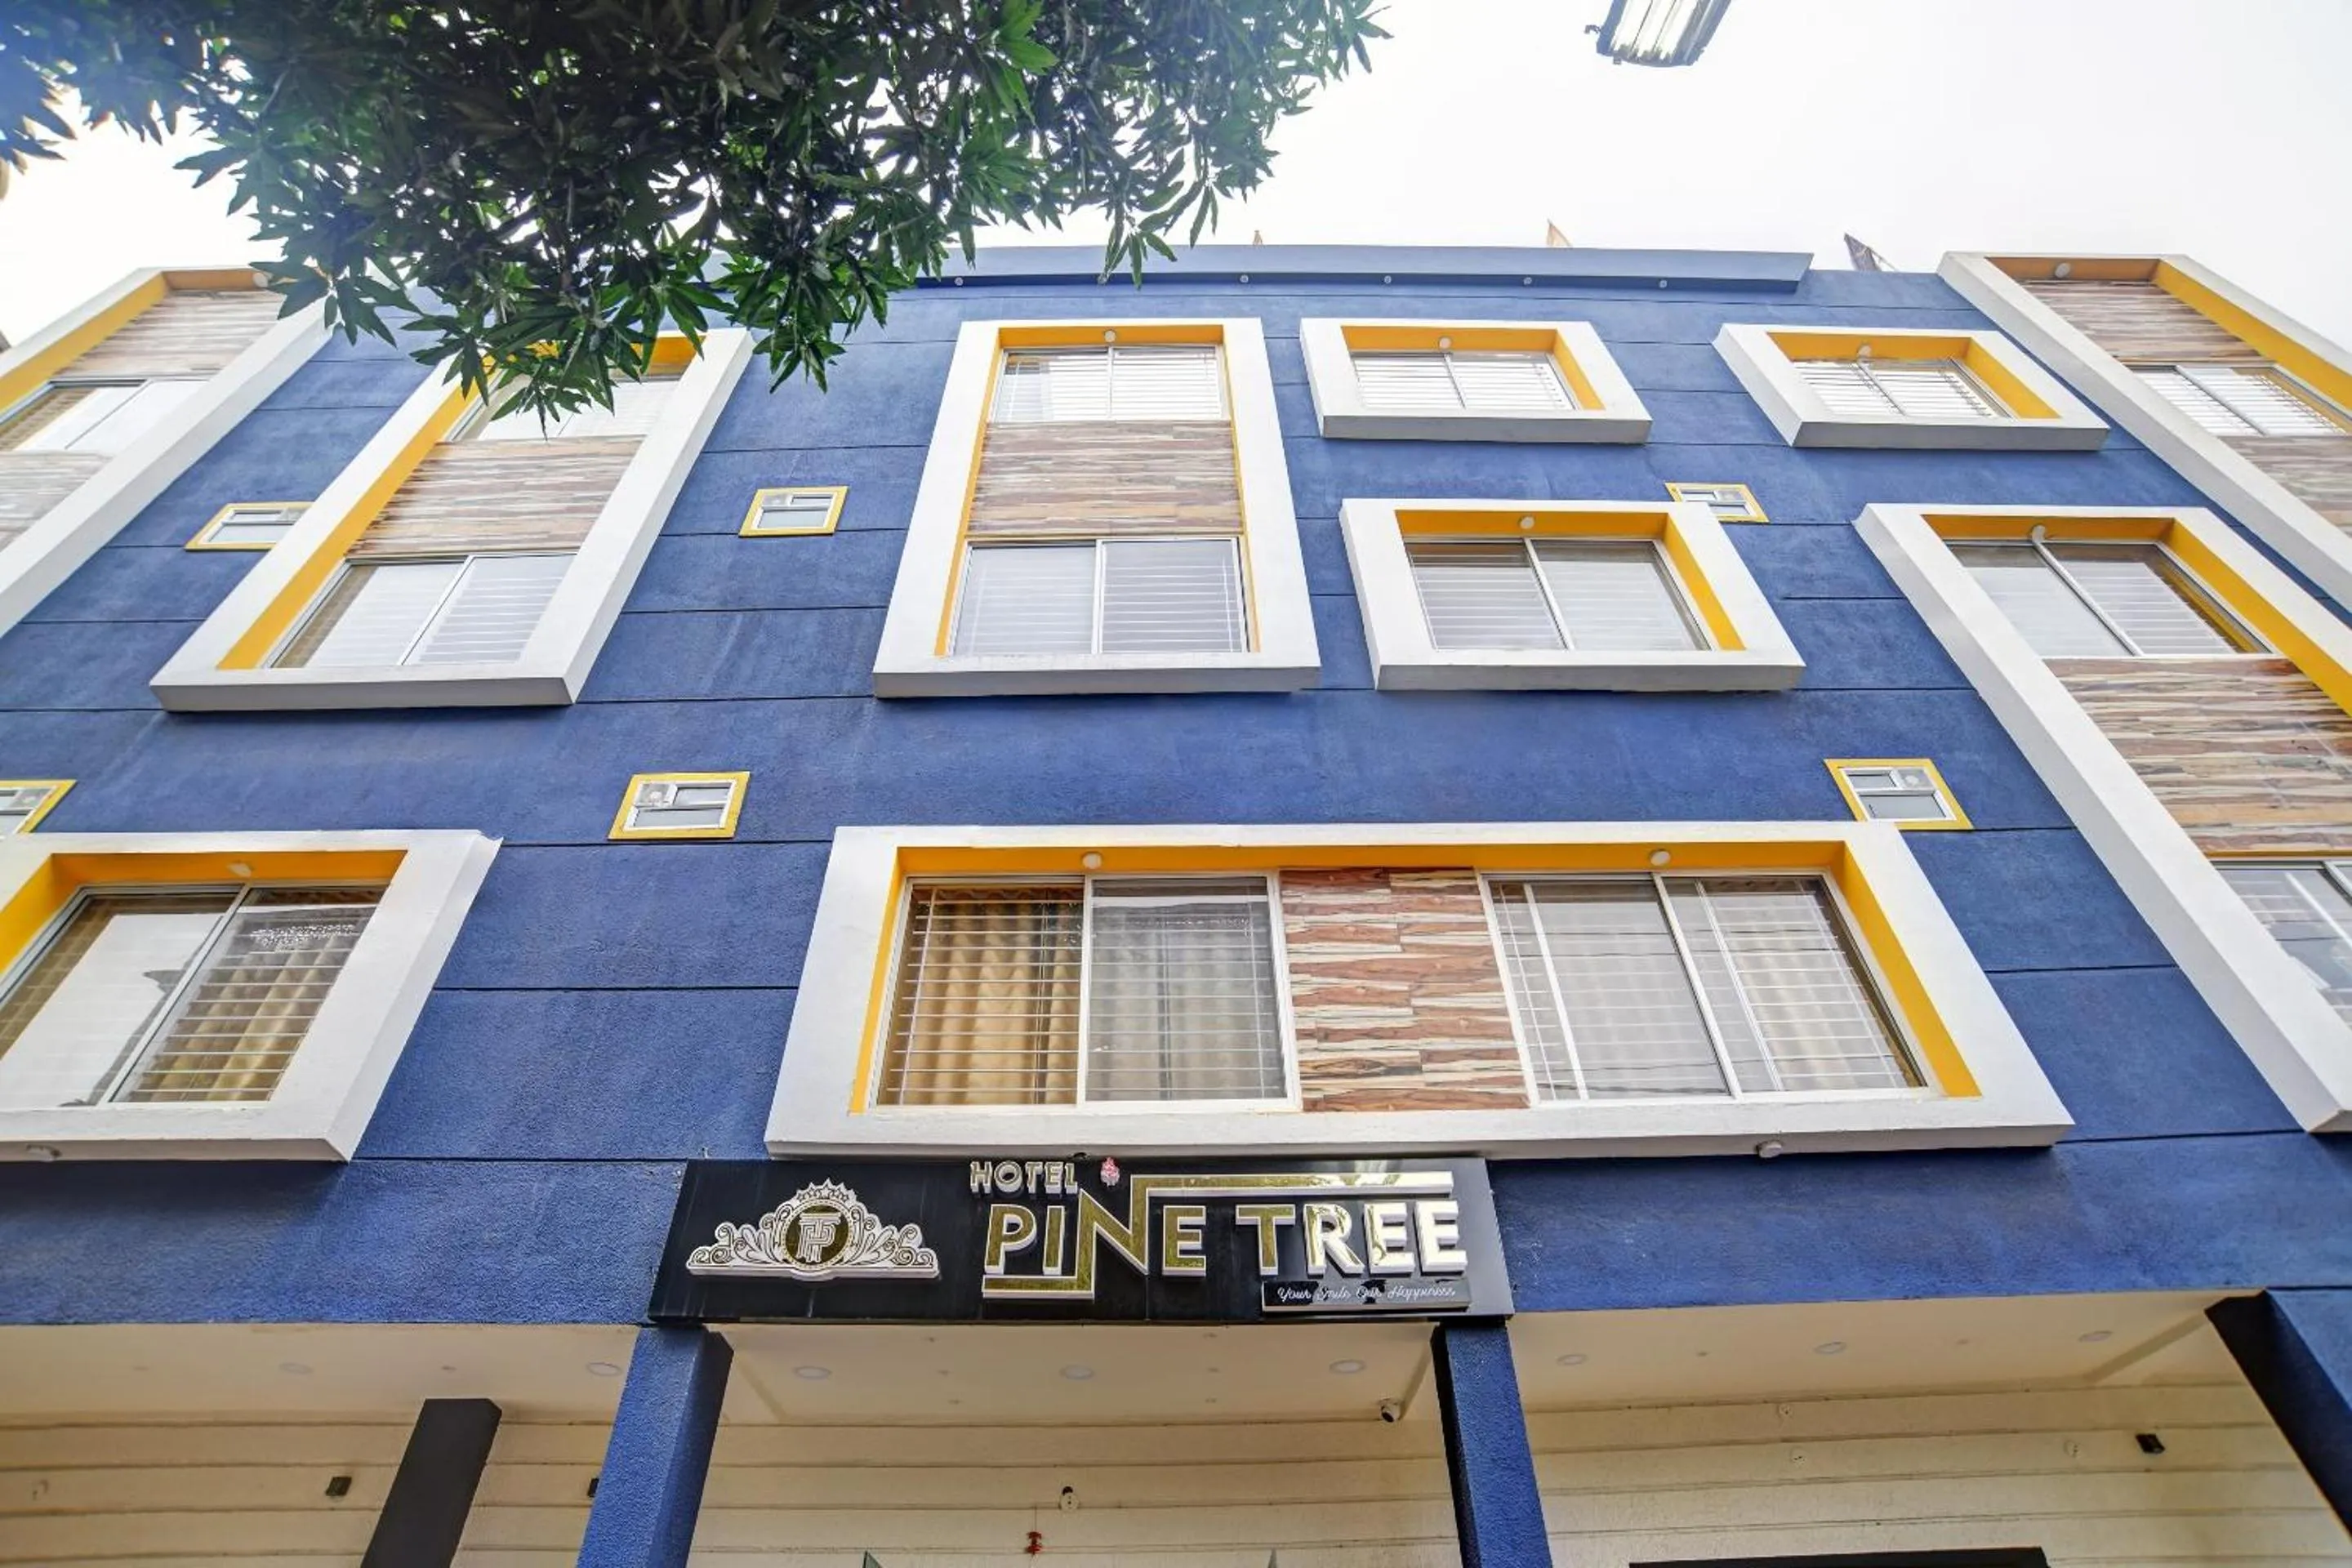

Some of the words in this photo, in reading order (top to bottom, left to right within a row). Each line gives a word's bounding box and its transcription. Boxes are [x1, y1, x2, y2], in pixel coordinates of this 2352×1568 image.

[970, 1160, 1078, 1194] HOTEL
[982, 1174, 1207, 1298] PINE
[1235, 1200, 1468, 1275] TREE
